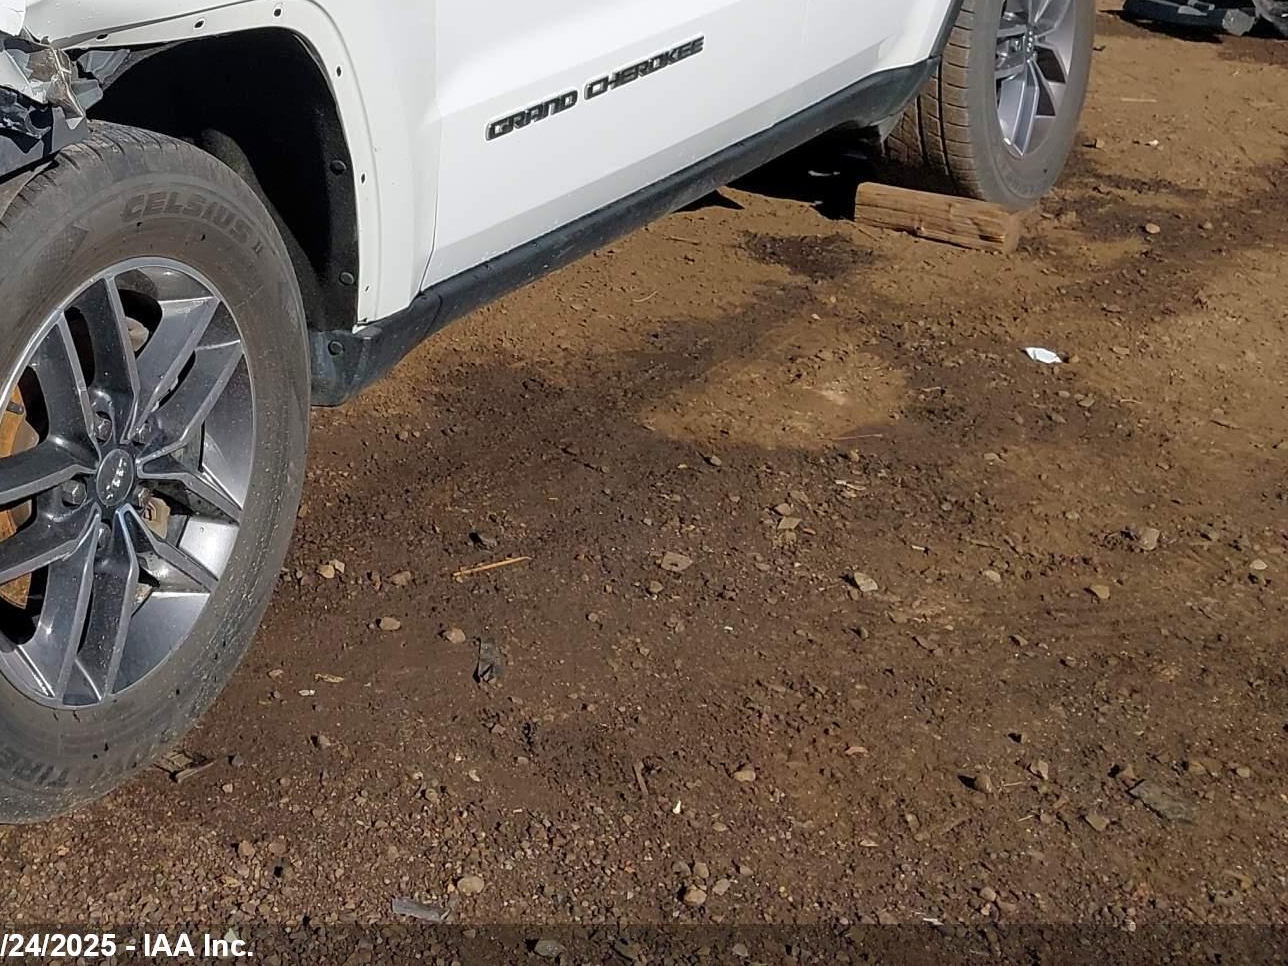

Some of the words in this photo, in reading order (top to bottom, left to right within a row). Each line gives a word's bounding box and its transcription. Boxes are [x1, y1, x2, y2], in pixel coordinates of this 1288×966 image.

[484, 88, 579, 142] GRAND
[583, 35, 705, 101] CHEROKEE
[120, 191, 253, 245] CELSIUS
